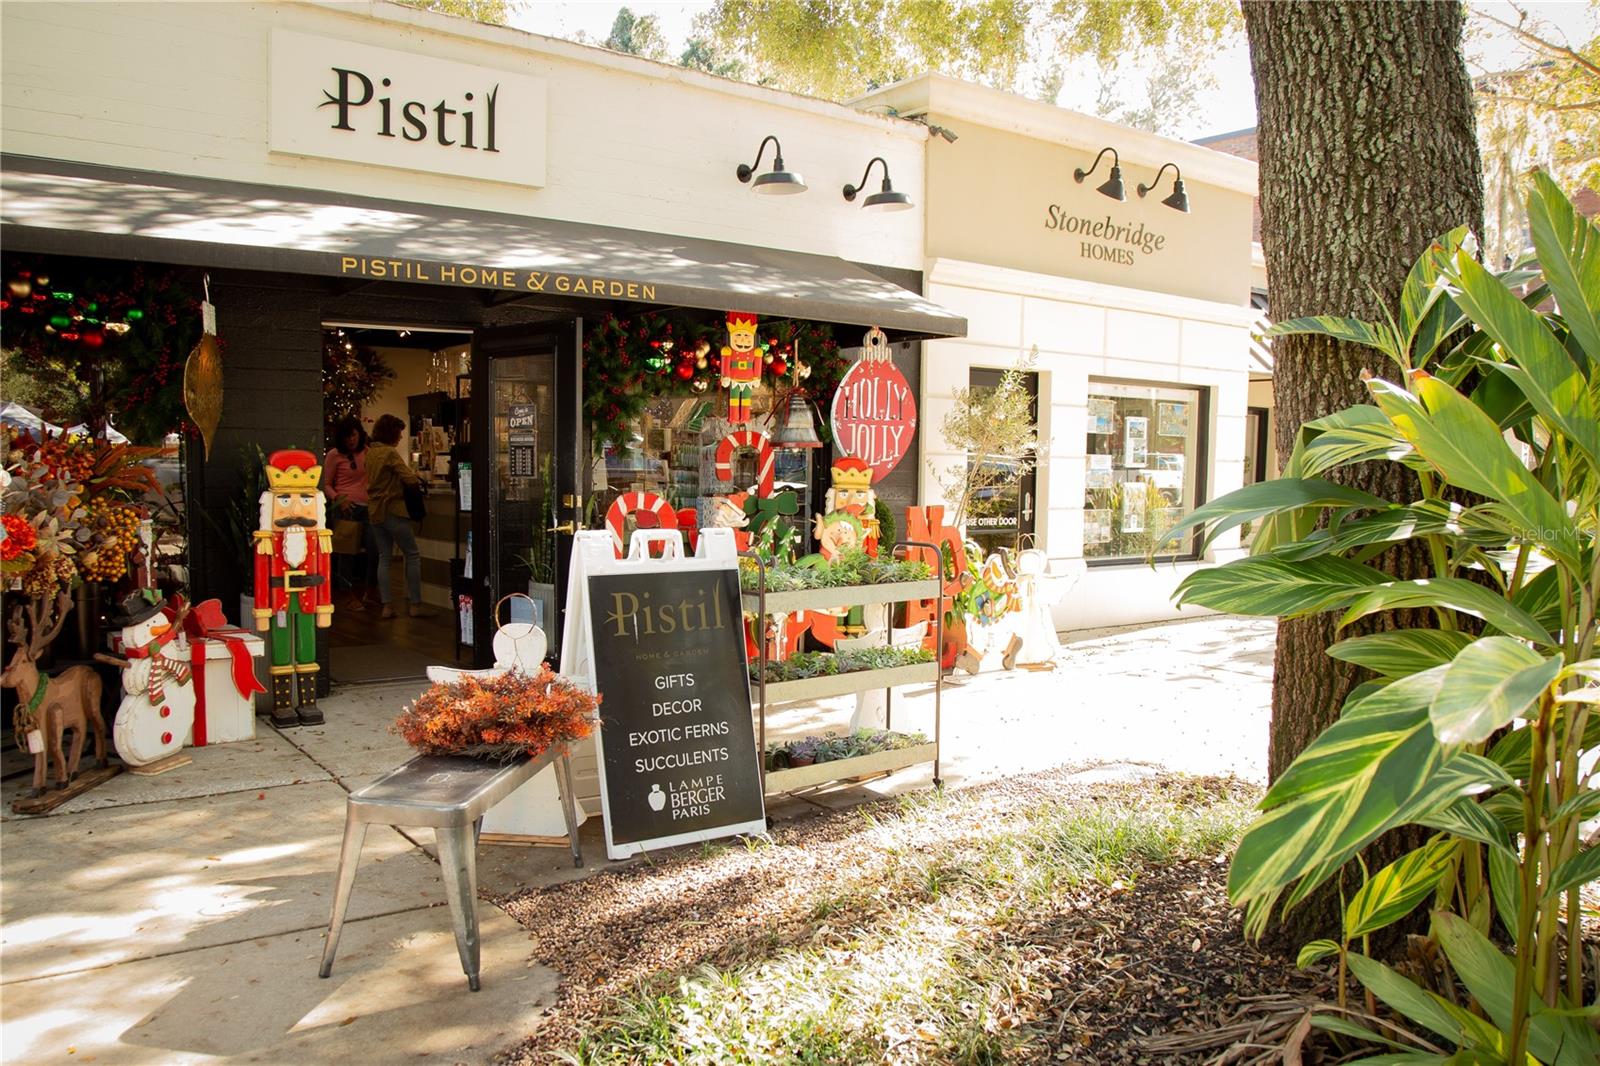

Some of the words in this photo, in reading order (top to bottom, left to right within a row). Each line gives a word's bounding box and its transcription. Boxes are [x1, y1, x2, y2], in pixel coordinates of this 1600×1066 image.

[317, 67, 499, 153] Pistil
[1045, 204, 1165, 255] Stonebridge
[1080, 241, 1135, 266] HOMES
[341, 256, 429, 281] PISTIL
[440, 265, 516, 288] HOME
[526, 271, 549, 291] &
[555, 276, 656, 300] GARDEN
[843, 377, 908, 421] HOLLY
[510, 414, 534, 428] OPEN
[846, 423, 905, 466] JOLLY
[978, 517, 998, 526] OTHER
[998, 517, 1018, 526] DOOR
[603, 577, 726, 637] Pistil
[654, 673, 695, 689] GIFTS
[652, 699, 702, 717] DECOR
[629, 727, 682, 747] EXOTIC
[684, 721, 729, 739] FERNS
[634, 747, 729, 773] SUCCULENTS
[669, 774, 723, 793] LAMPE
[671, 785, 726, 809] BERGER
[672, 804, 711, 820] PARIS
